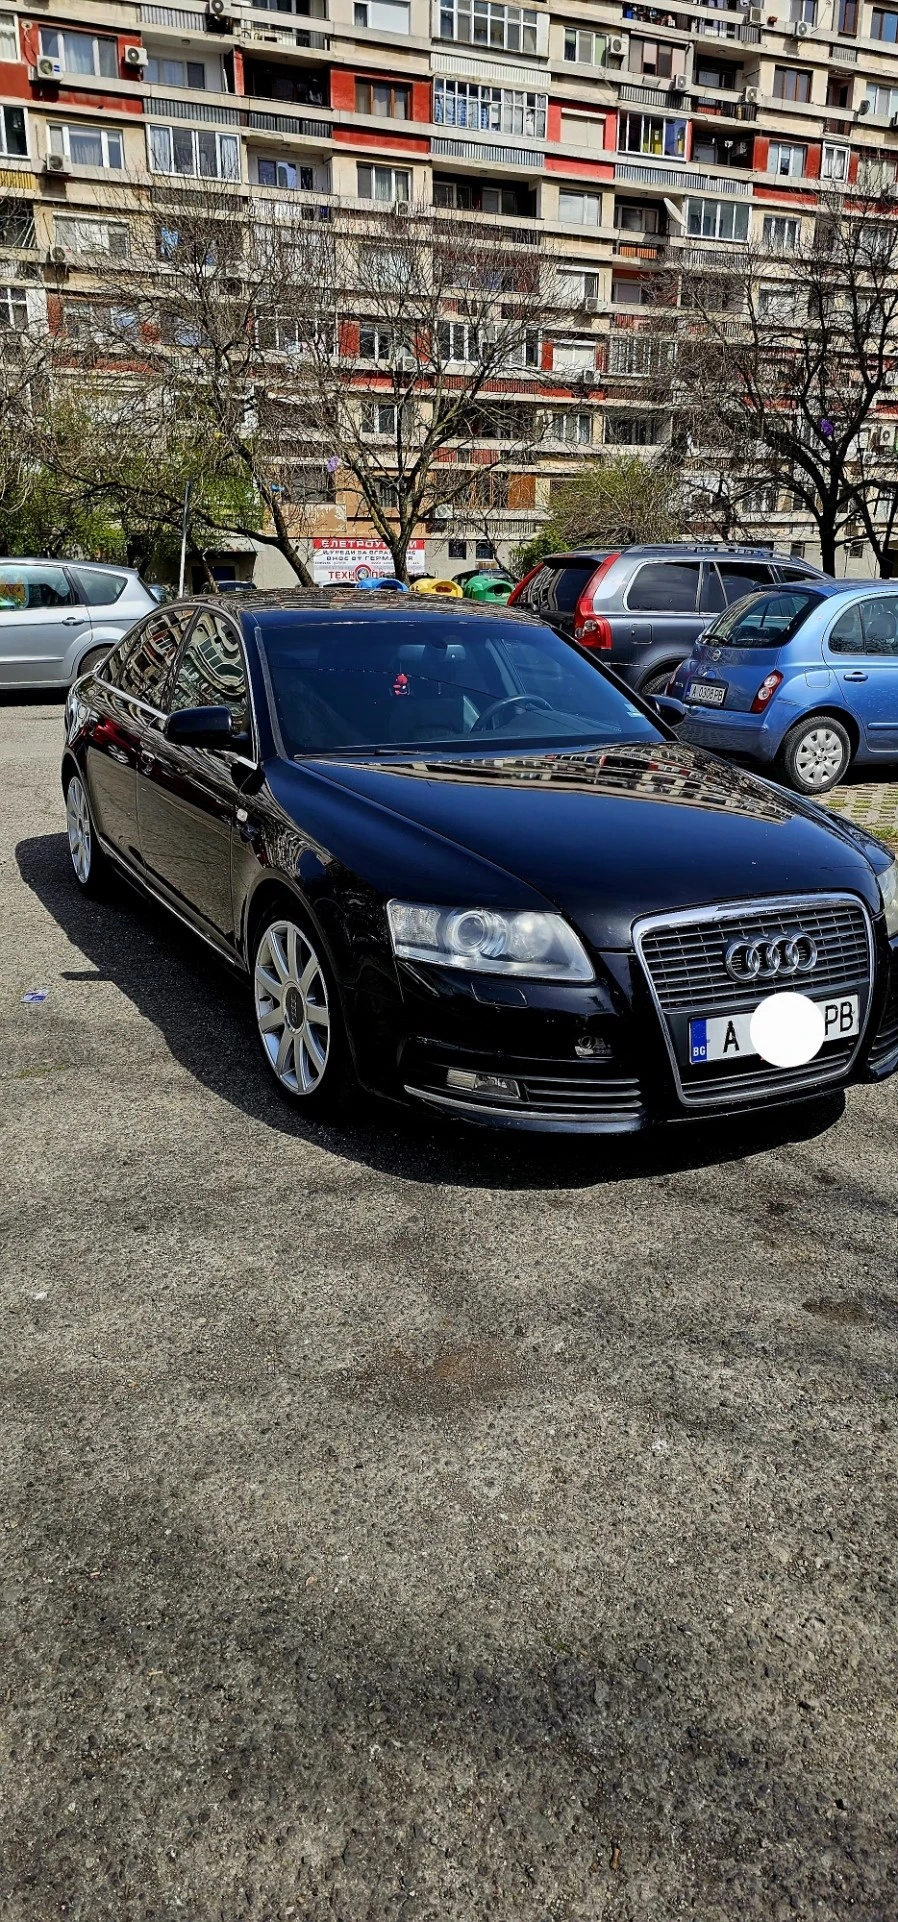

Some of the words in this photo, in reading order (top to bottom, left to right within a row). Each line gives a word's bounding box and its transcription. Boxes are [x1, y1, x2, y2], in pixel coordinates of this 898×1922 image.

[722, 1020, 740, 1053] A
[824, 1001, 854, 1036] PB
[692, 1046, 706, 1057] BG
